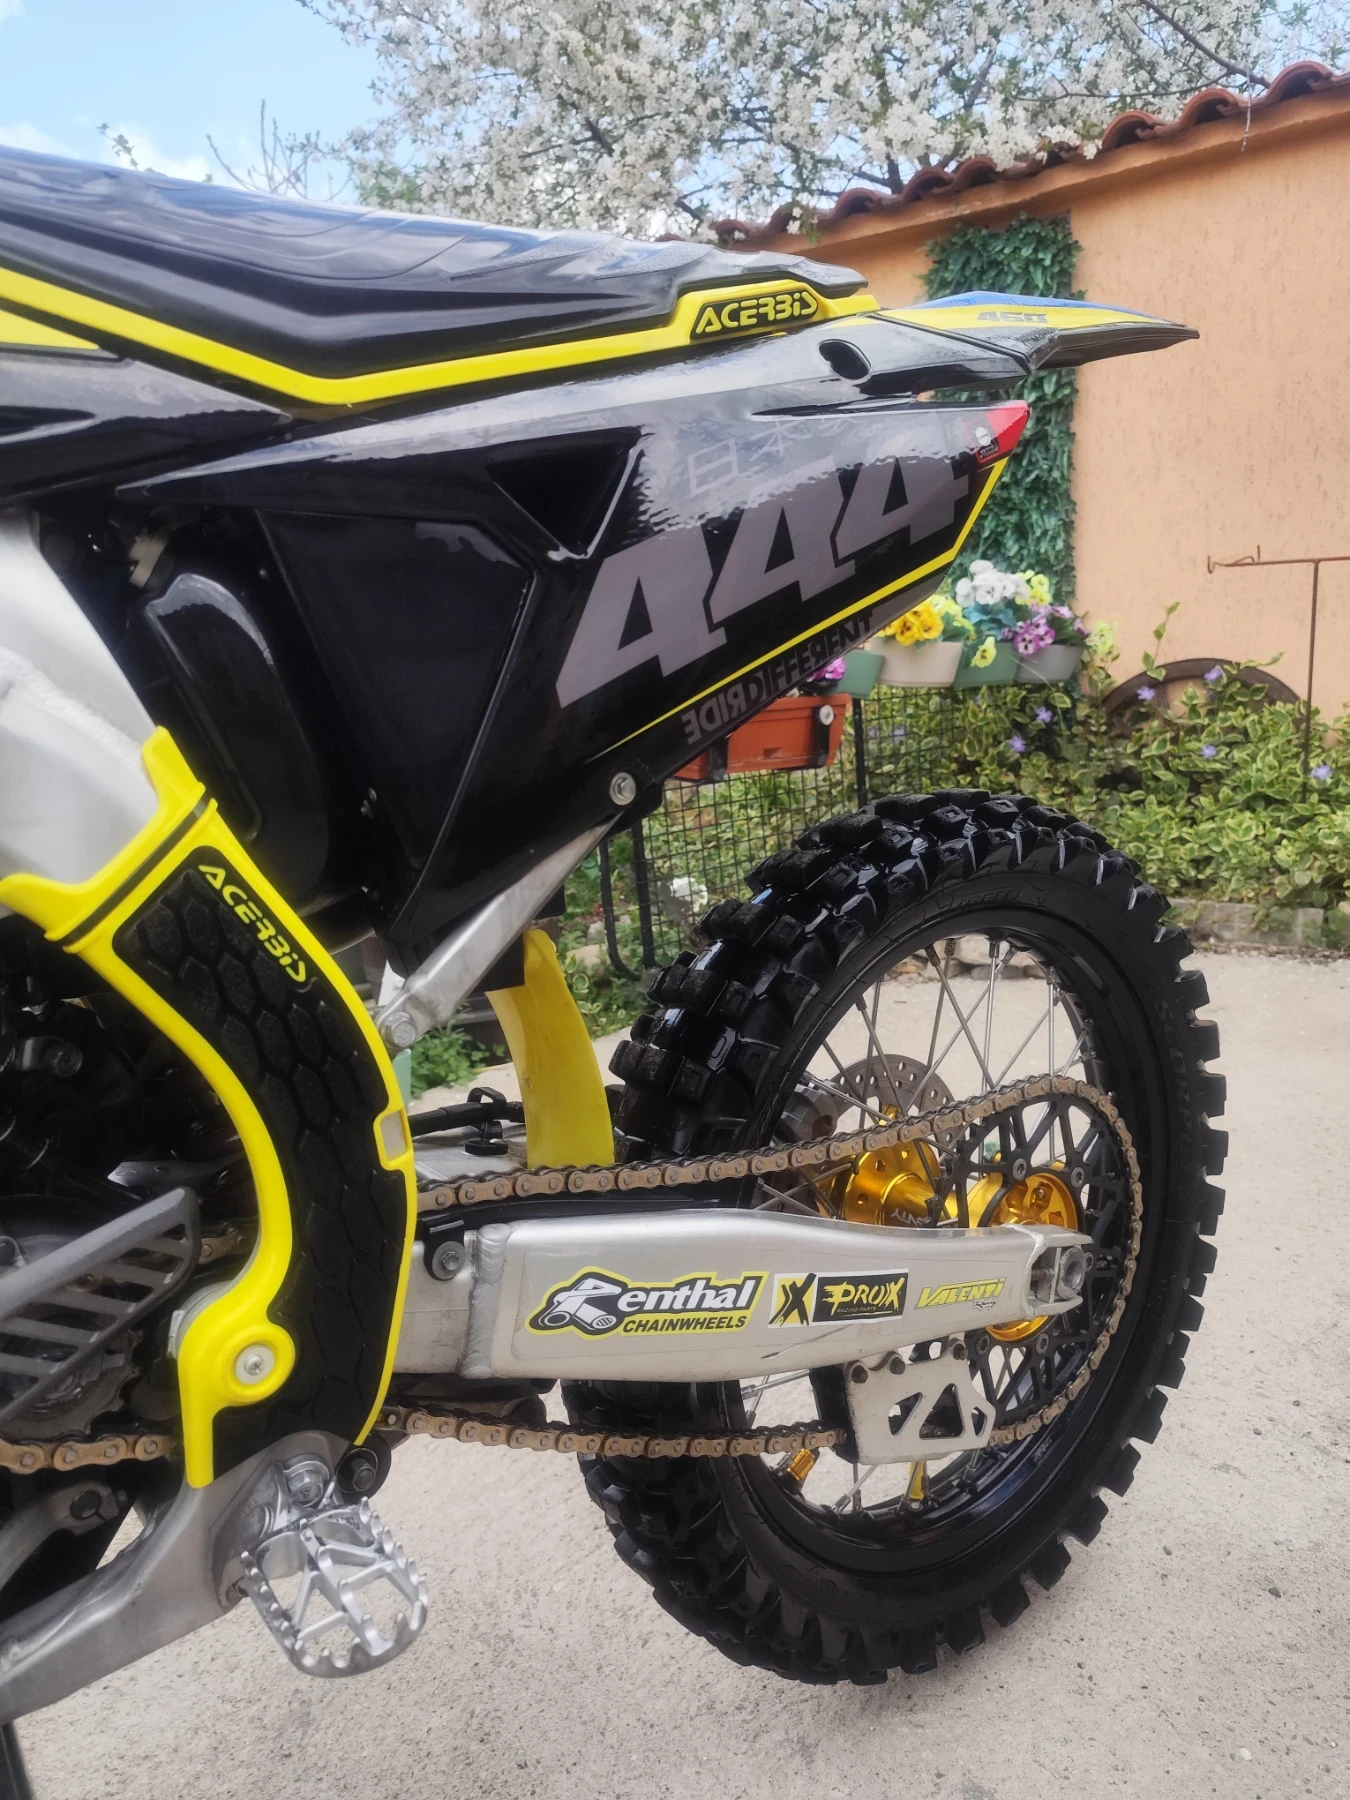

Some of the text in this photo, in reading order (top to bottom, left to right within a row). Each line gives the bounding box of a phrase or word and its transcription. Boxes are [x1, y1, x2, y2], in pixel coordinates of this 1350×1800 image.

[977, 311, 1049, 324] 450
[555, 410, 970, 709] 444
[622, 1315, 747, 1333] CHAINWHEELS
